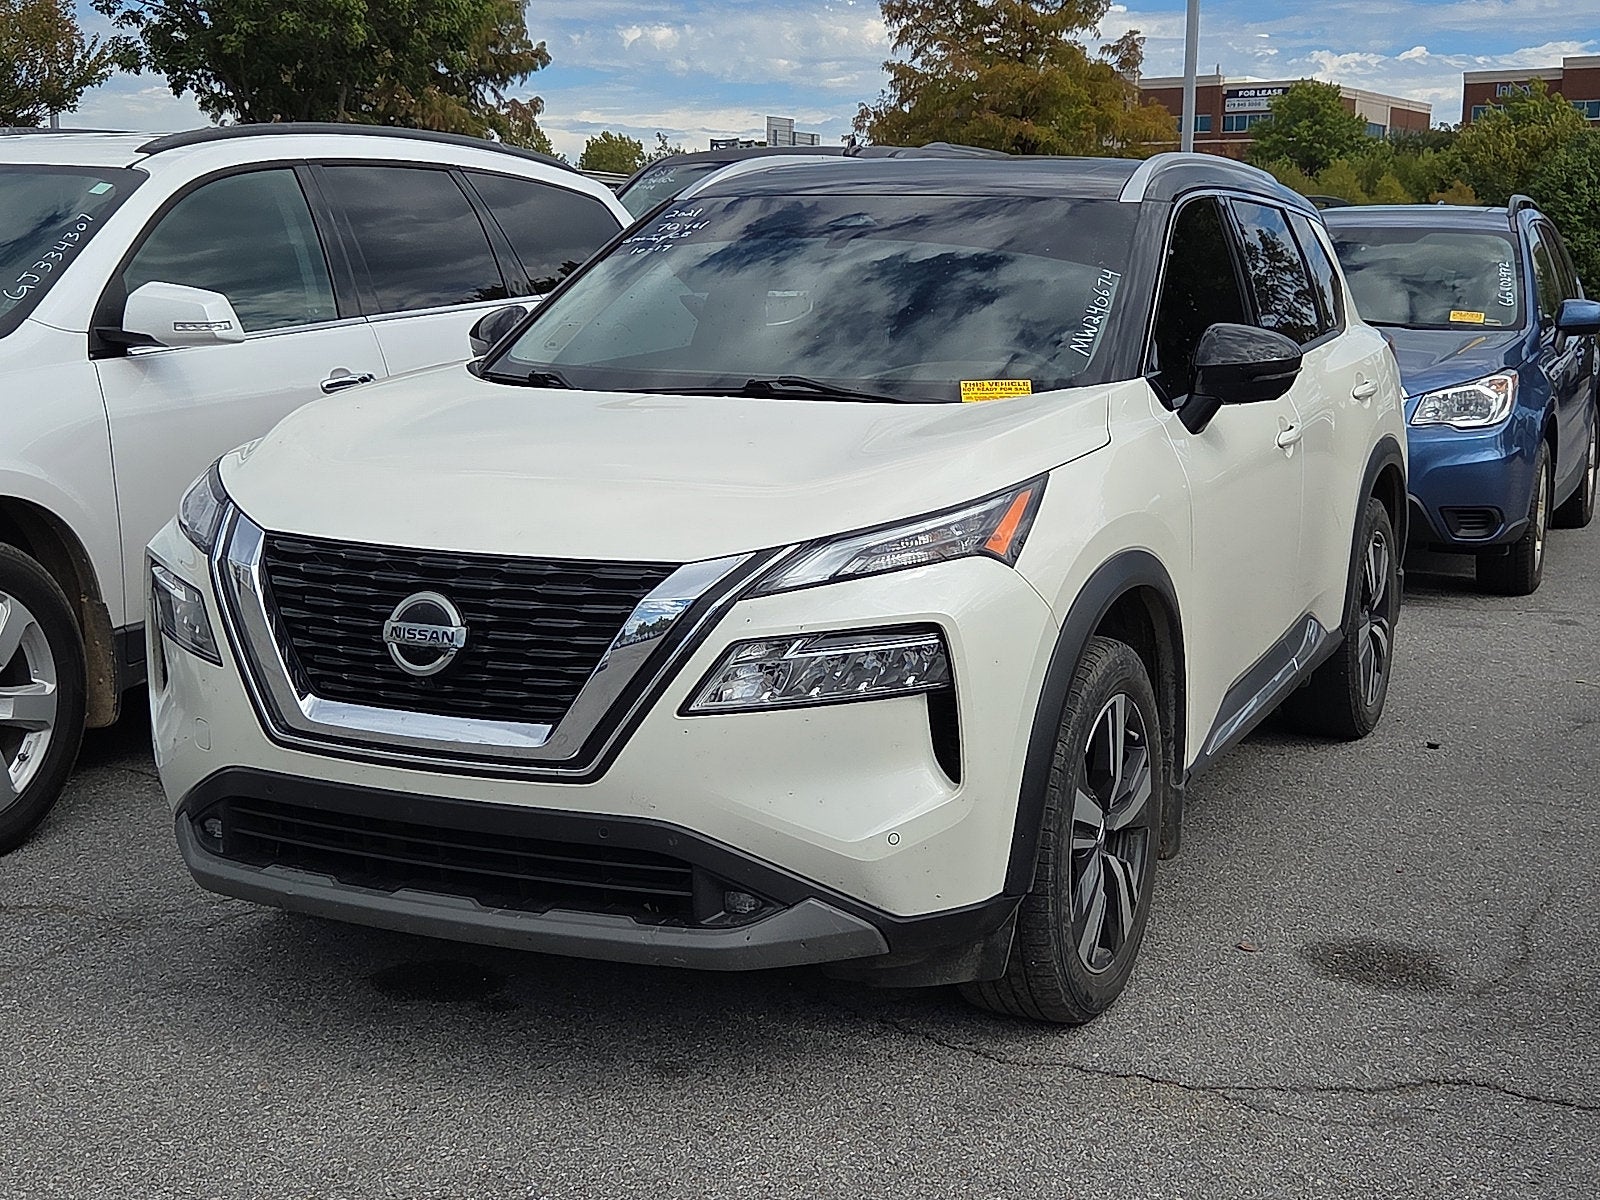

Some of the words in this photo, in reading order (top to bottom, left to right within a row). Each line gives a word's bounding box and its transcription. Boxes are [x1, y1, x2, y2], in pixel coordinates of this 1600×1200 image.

[1256, 88, 1283, 96] LEASE
[665, 207, 703, 219] 2021
[1069, 268, 1121, 357] MW240674
[390, 625, 455, 644] NISSAN
